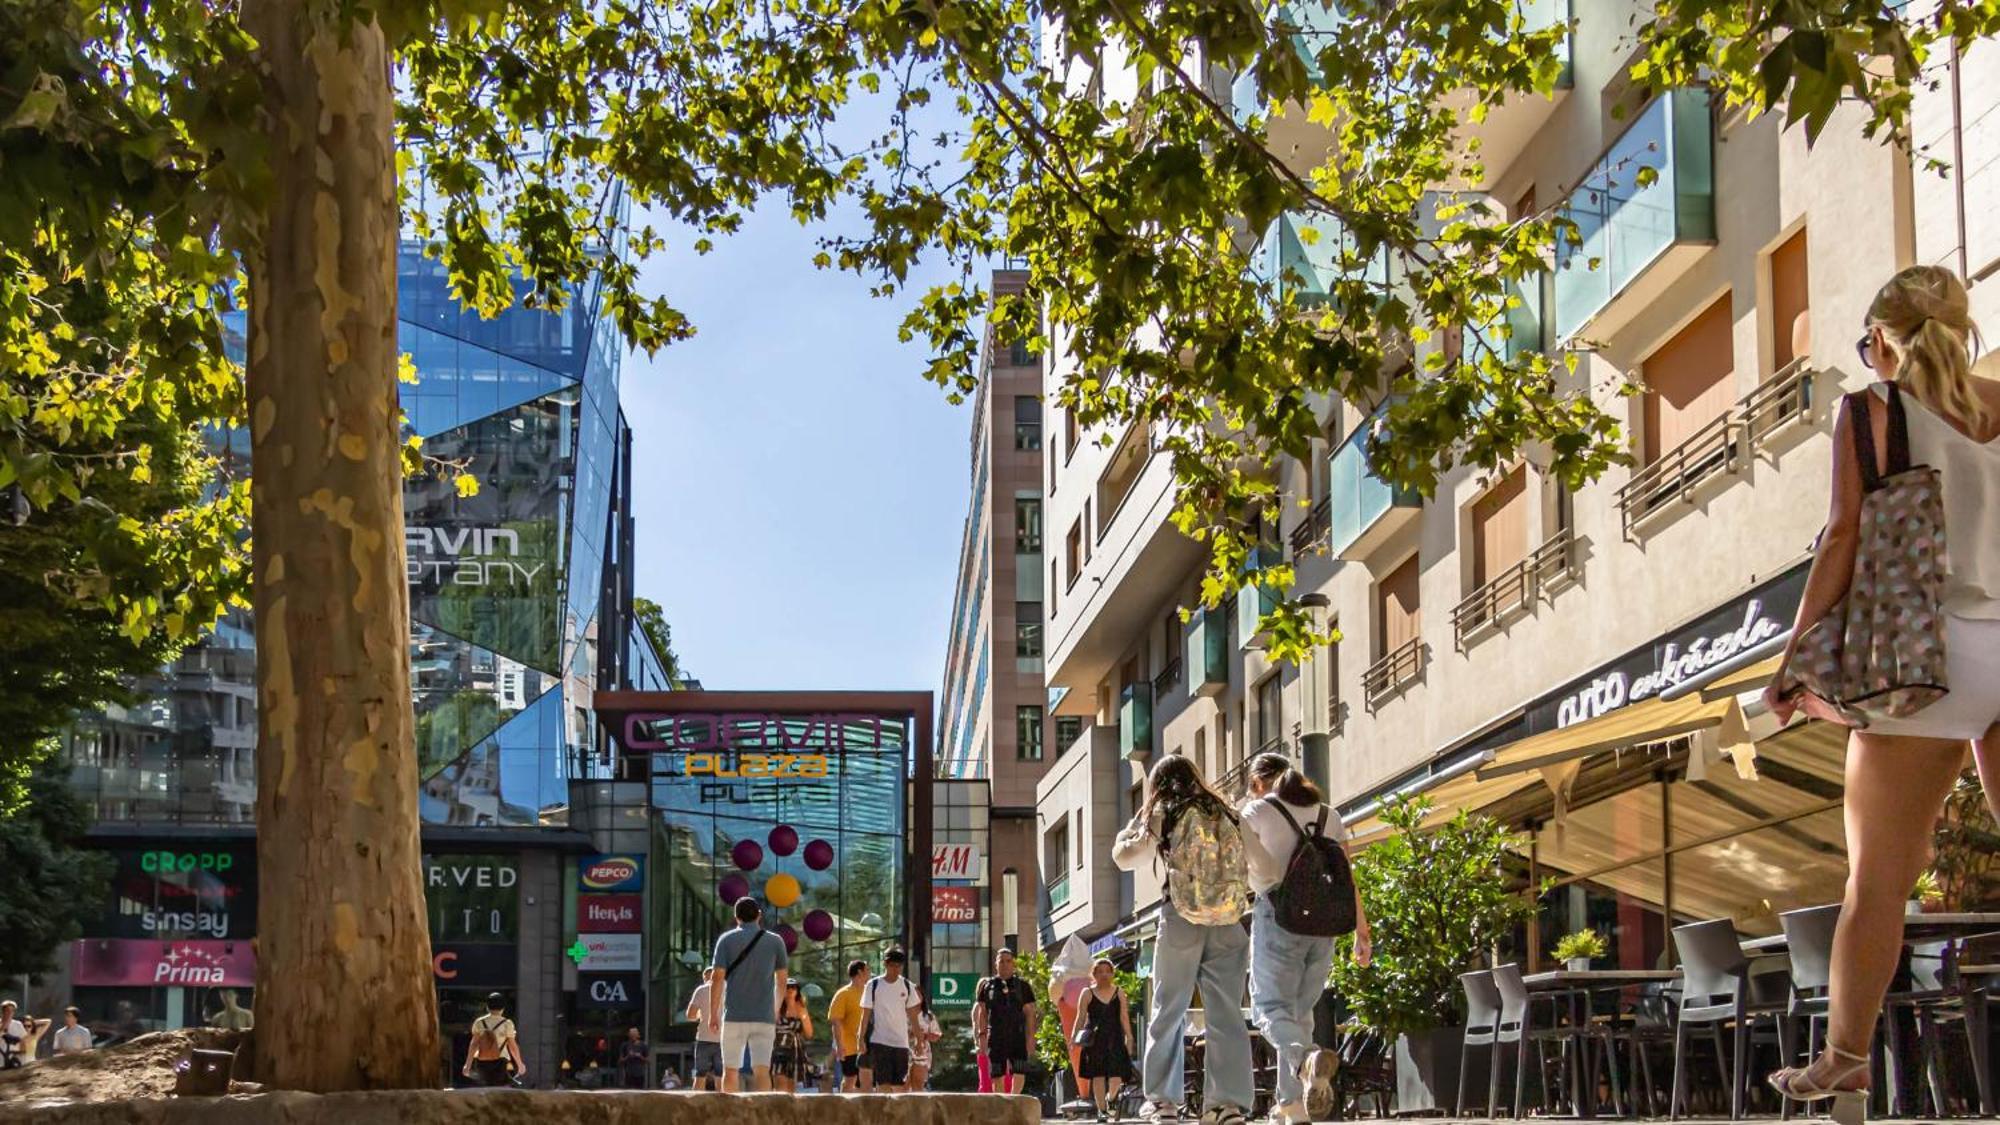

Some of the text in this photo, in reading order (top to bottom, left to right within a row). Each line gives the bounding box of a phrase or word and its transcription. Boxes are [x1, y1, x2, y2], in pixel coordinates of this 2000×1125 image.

[141, 851, 233, 872] CROPP
[591, 868, 630, 878] PEPCO
[141, 906, 229, 938] sinsay
[589, 904, 633, 923] Hervis
[590, 980, 629, 1002] C&A
[939, 977, 958, 996] D
